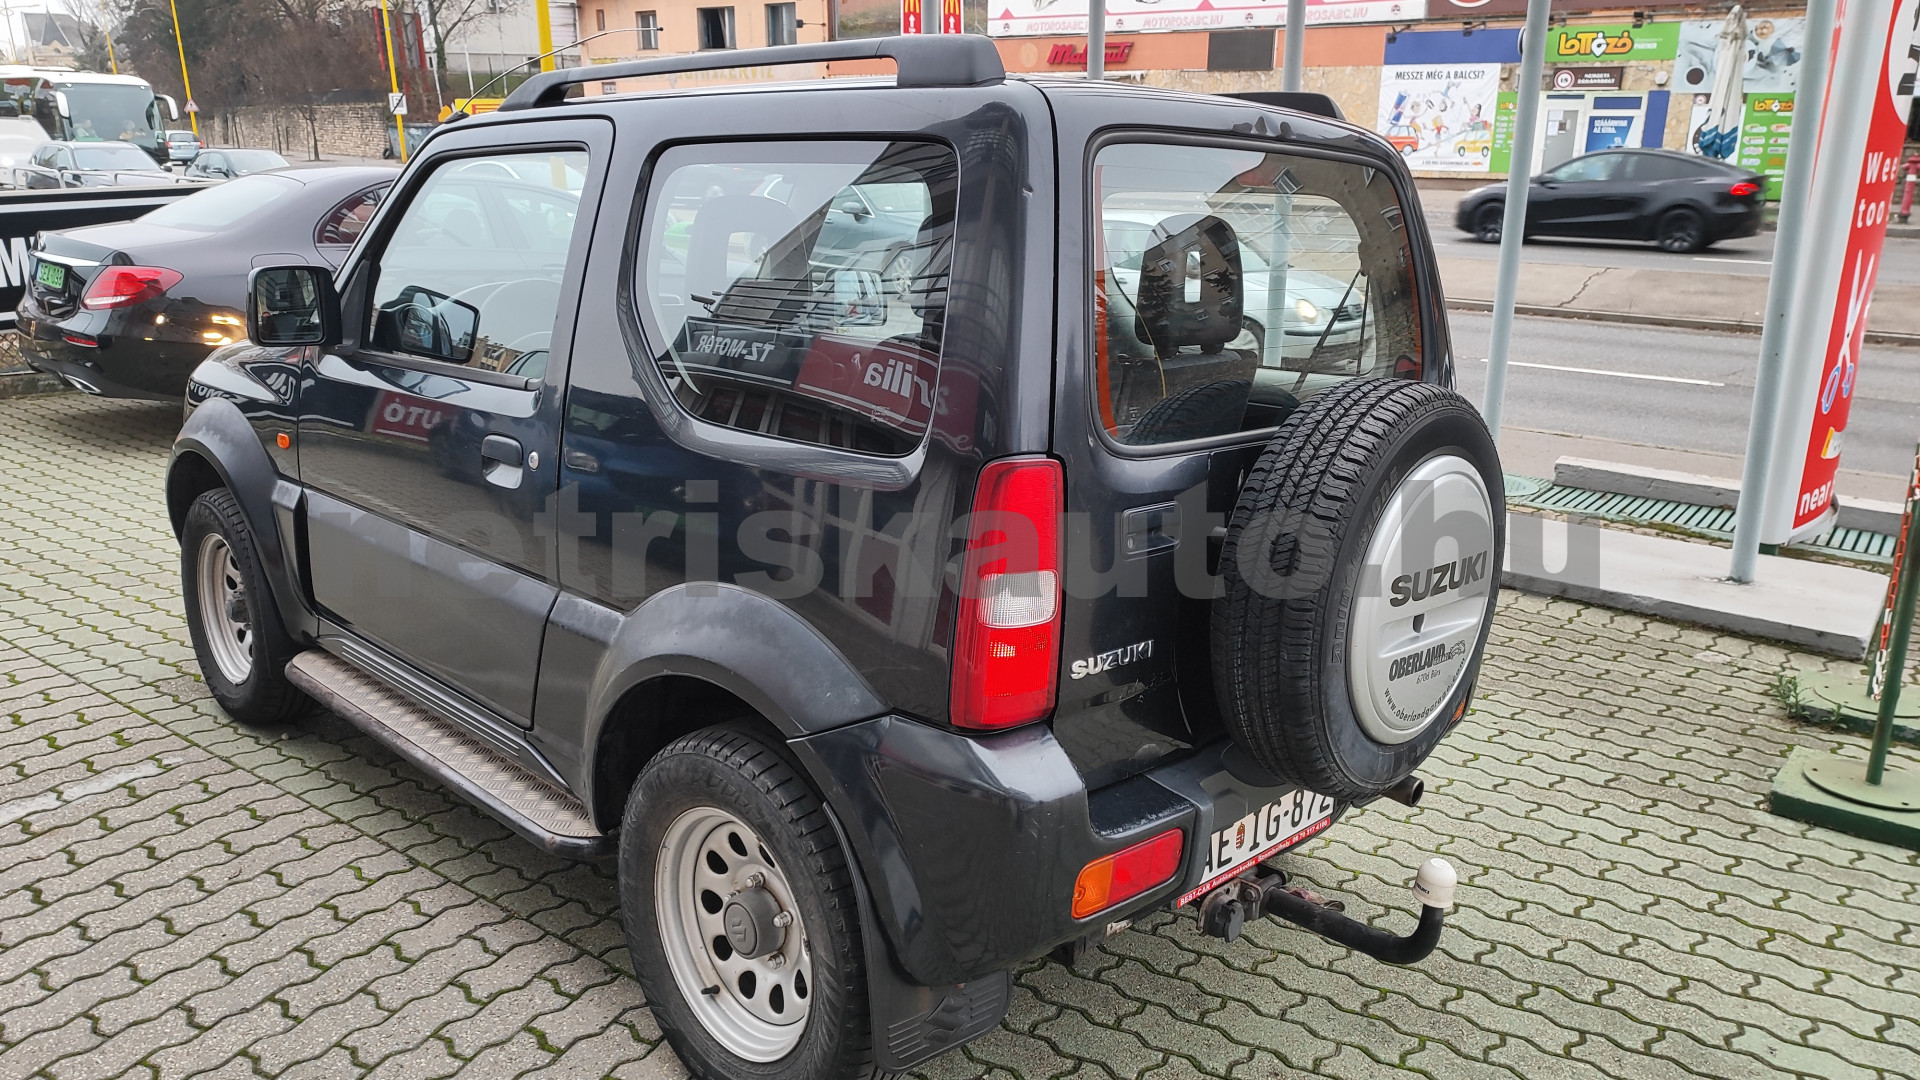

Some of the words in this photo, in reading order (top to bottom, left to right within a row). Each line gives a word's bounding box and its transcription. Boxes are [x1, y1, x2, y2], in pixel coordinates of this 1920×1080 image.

[1026, 16, 1088, 32] MOTOROSABC.
[1395, 71, 1423, 80] MESSZE
[1426, 69, 1443, 80] MÉG
[1445, 71, 1451, 79] A
[1453, 70, 1485, 80] BALCSI?
[1856, 198, 1889, 228] too
[1389, 551, 1488, 608] SUZUKI
[1070, 640, 1154, 680] SUZUKI
[1389, 643, 1446, 682] OBERLAND
[1180, 883, 1210, 906] BEST-CAR
